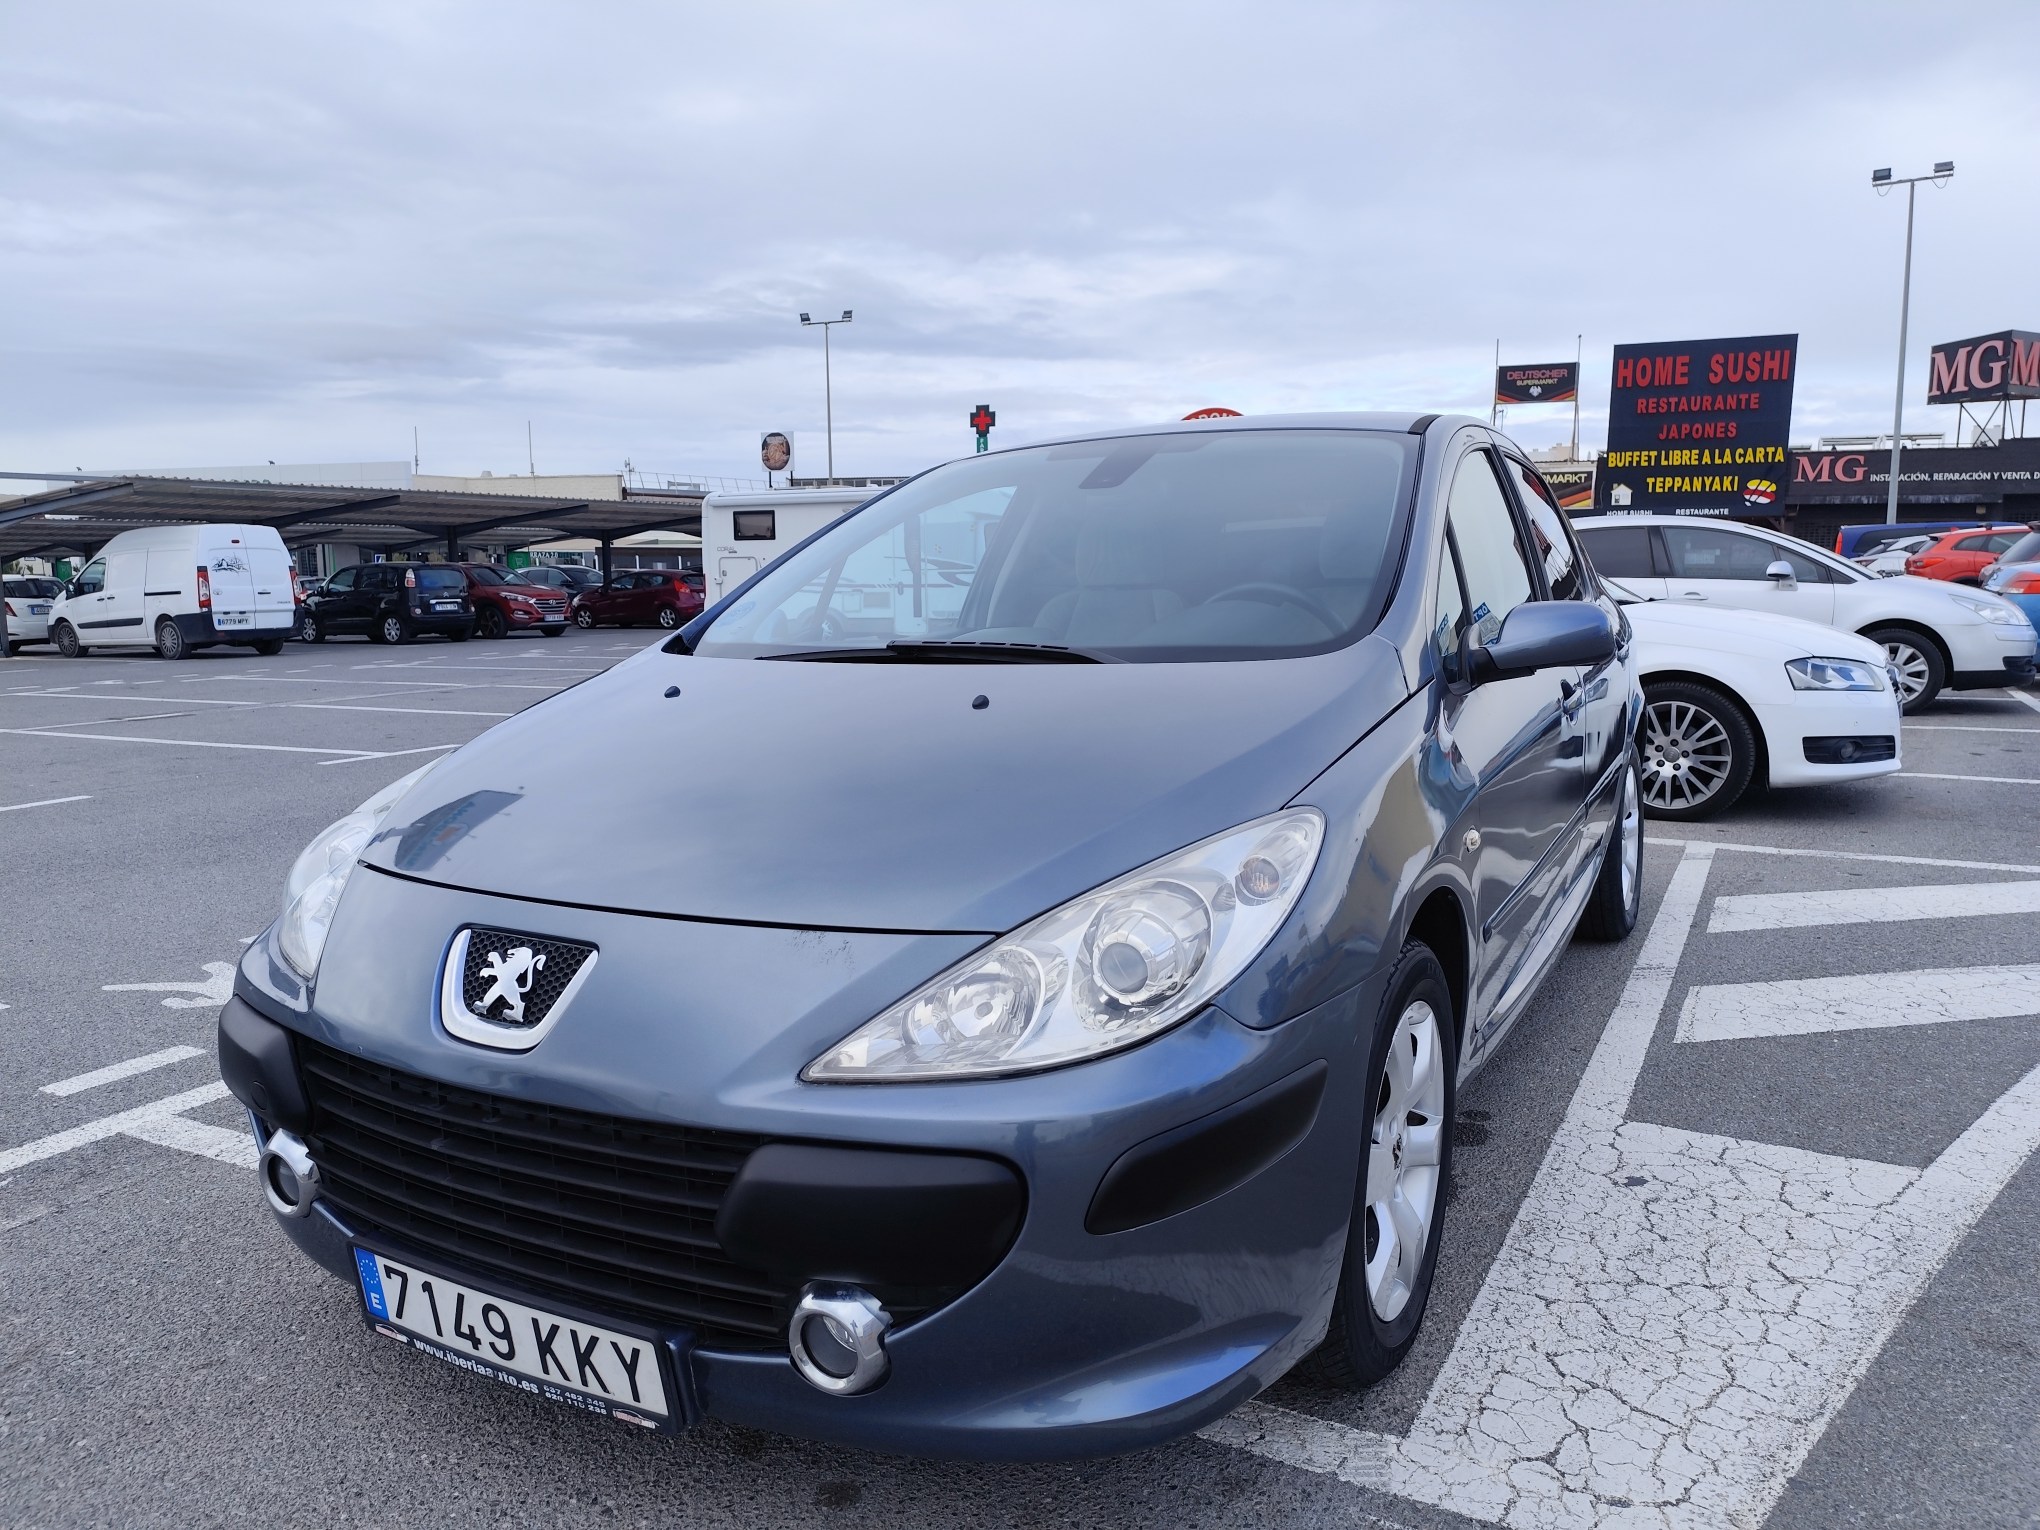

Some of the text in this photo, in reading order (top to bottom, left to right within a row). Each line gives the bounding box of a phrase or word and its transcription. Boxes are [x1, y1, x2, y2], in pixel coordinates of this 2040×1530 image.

[1507, 369, 1568, 380] DEUTSCHER
[1617, 350, 1790, 388] HOME SUSHI
[1928, 340, 2007, 396] MG
[1516, 378, 1558, 386] SUPERMARKT
[1637, 393, 1760, 414] RESTAURANTE
[1659, 422, 1737, 440] JAPONES
[1608, 446, 1784, 467] BUFFET LIBRE A LA CARTA
[1793, 455, 1868, 482] MG
[1870, 471, 1931, 482] INSTACIÓN,
[1933, 470, 1991, 480] REPARACIÓN
[1993, 472, 2000, 480] Y
[2001, 472, 2031, 480] VENTA
[1646, 475, 1739, 493] TEPPANYAKI
[1675, 508, 1729, 516] RESTAURANTE
[370, 1293, 382, 1310] E
[384, 1264, 640, 1403] 7149 KKY
